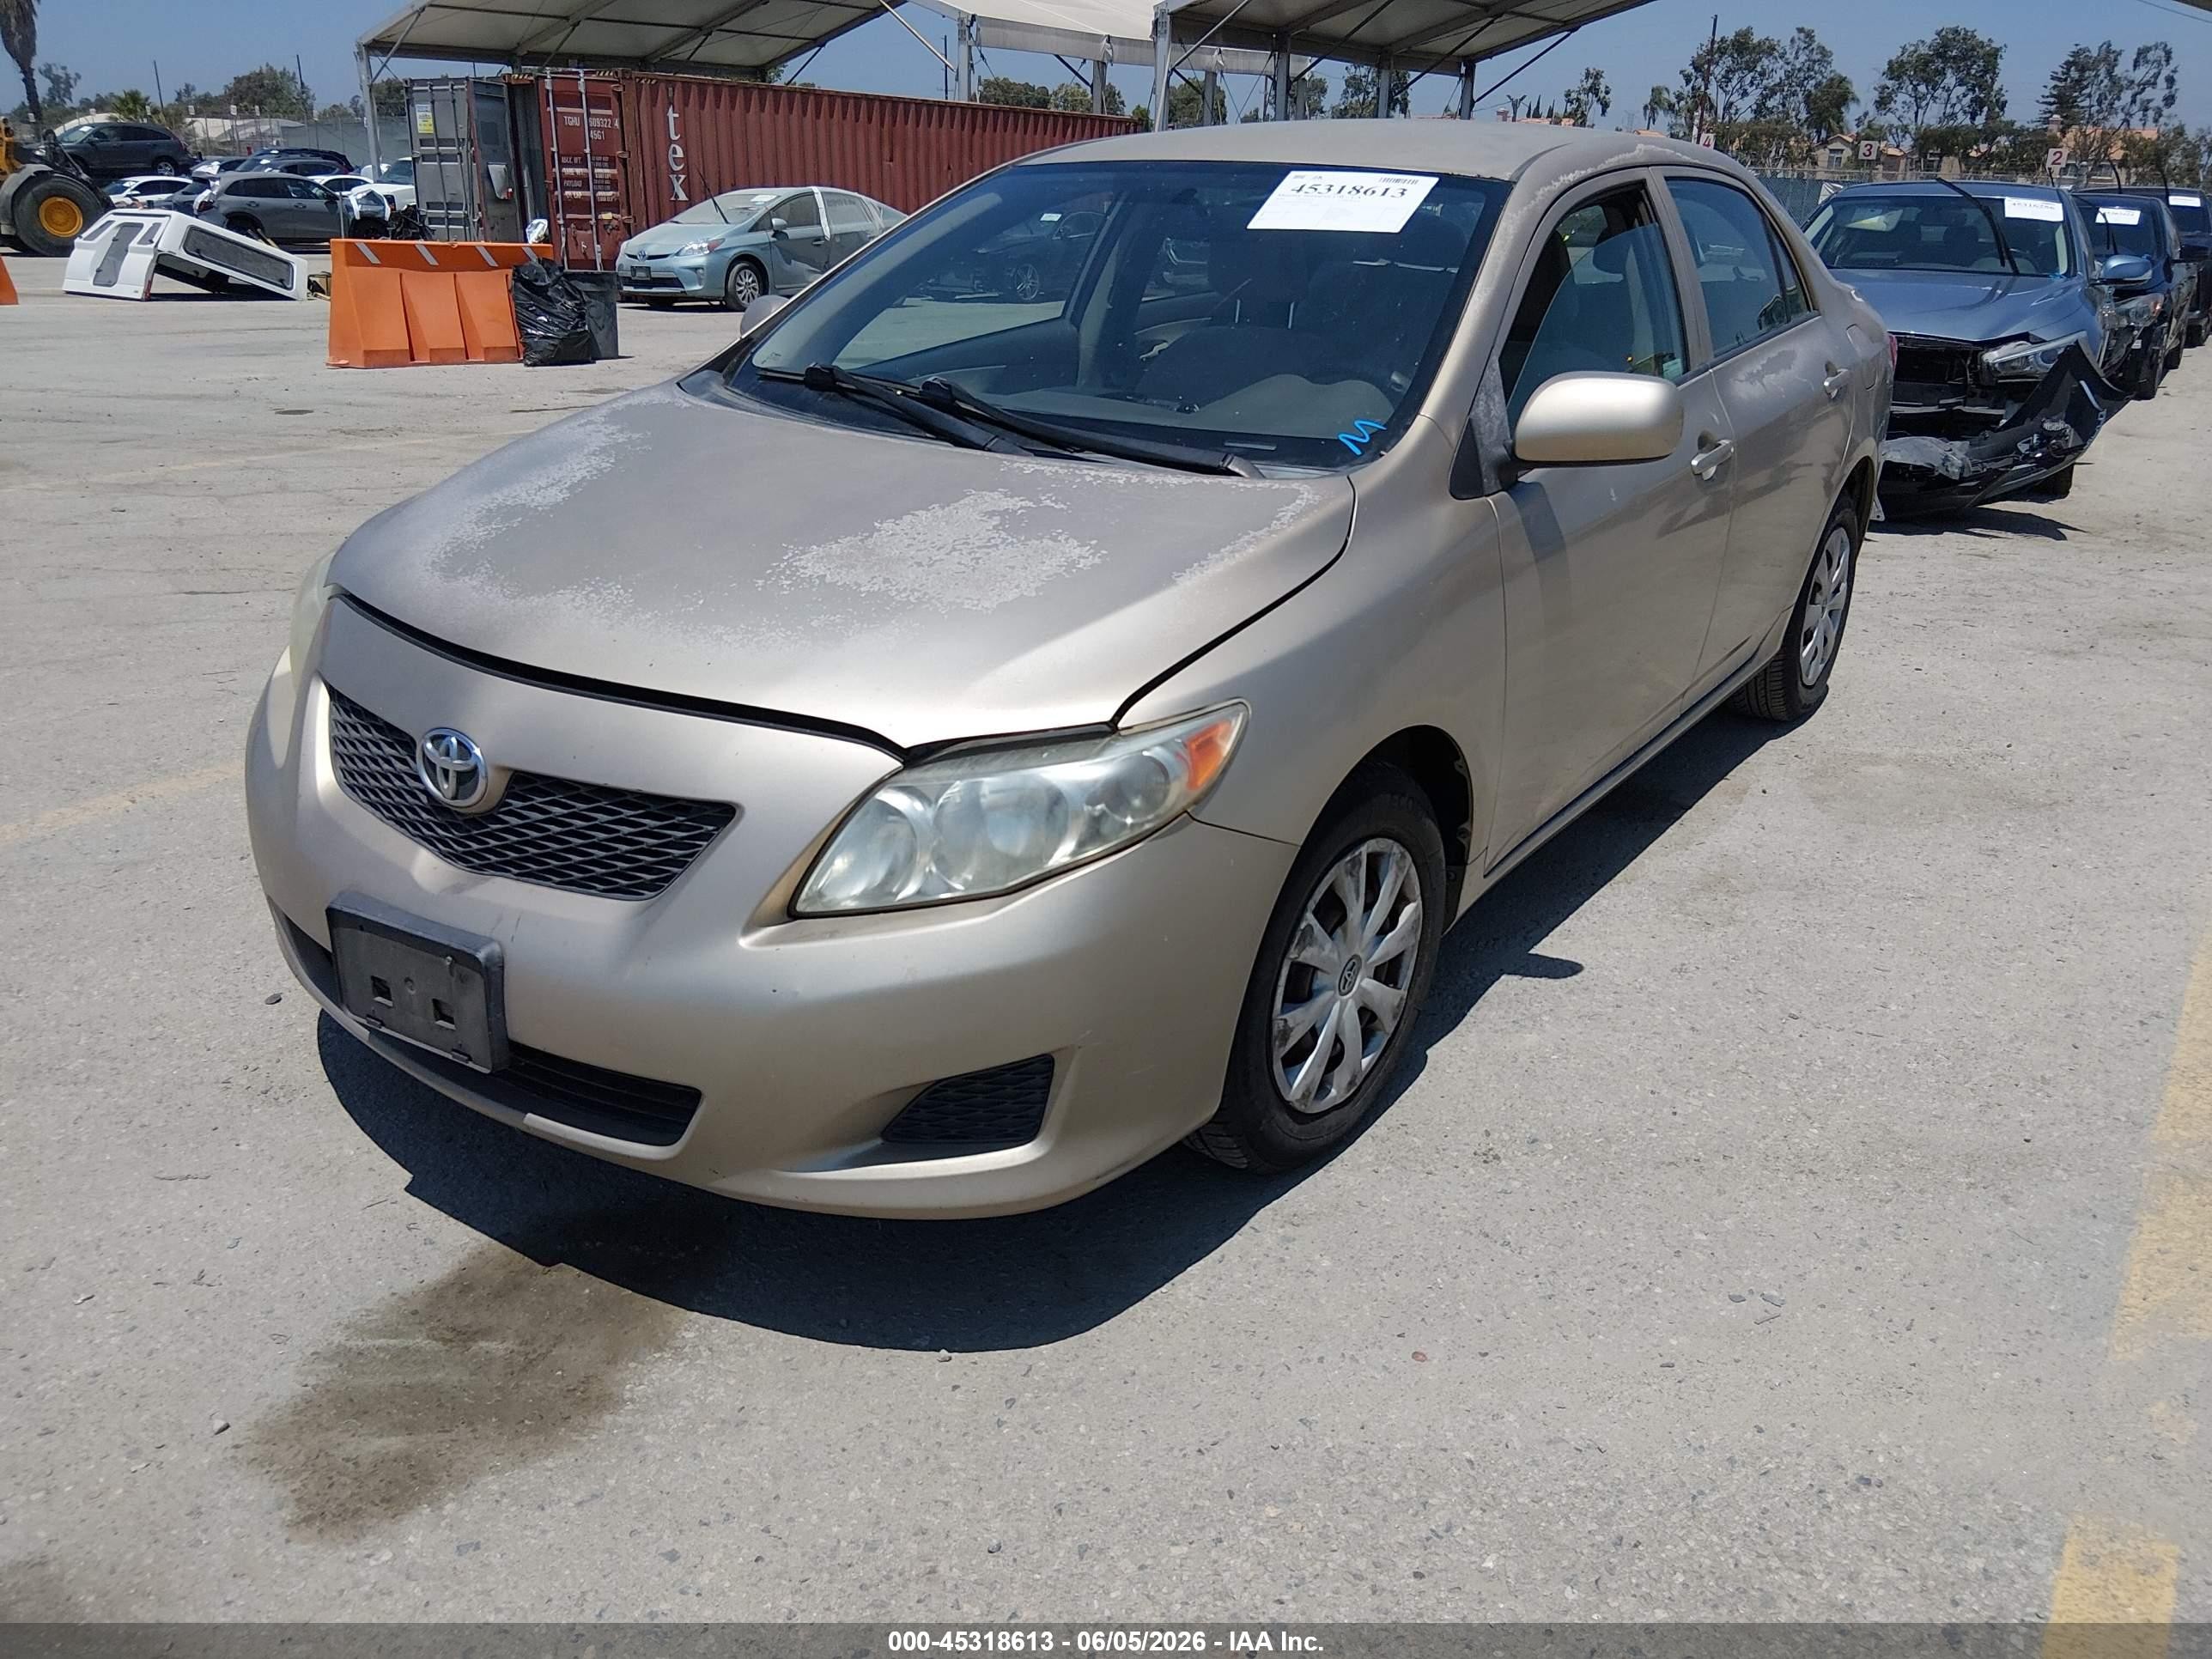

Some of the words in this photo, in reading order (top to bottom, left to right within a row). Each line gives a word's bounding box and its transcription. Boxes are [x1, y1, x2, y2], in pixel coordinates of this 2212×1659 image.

[563, 116, 580, 127] TGHU
[1703, 136, 1711, 148] 4
[666, 104, 690, 201] tex
[1863, 143, 1873, 157] 3
[2051, 150, 2063, 166] 2
[1291, 183, 1408, 199] 45318613
